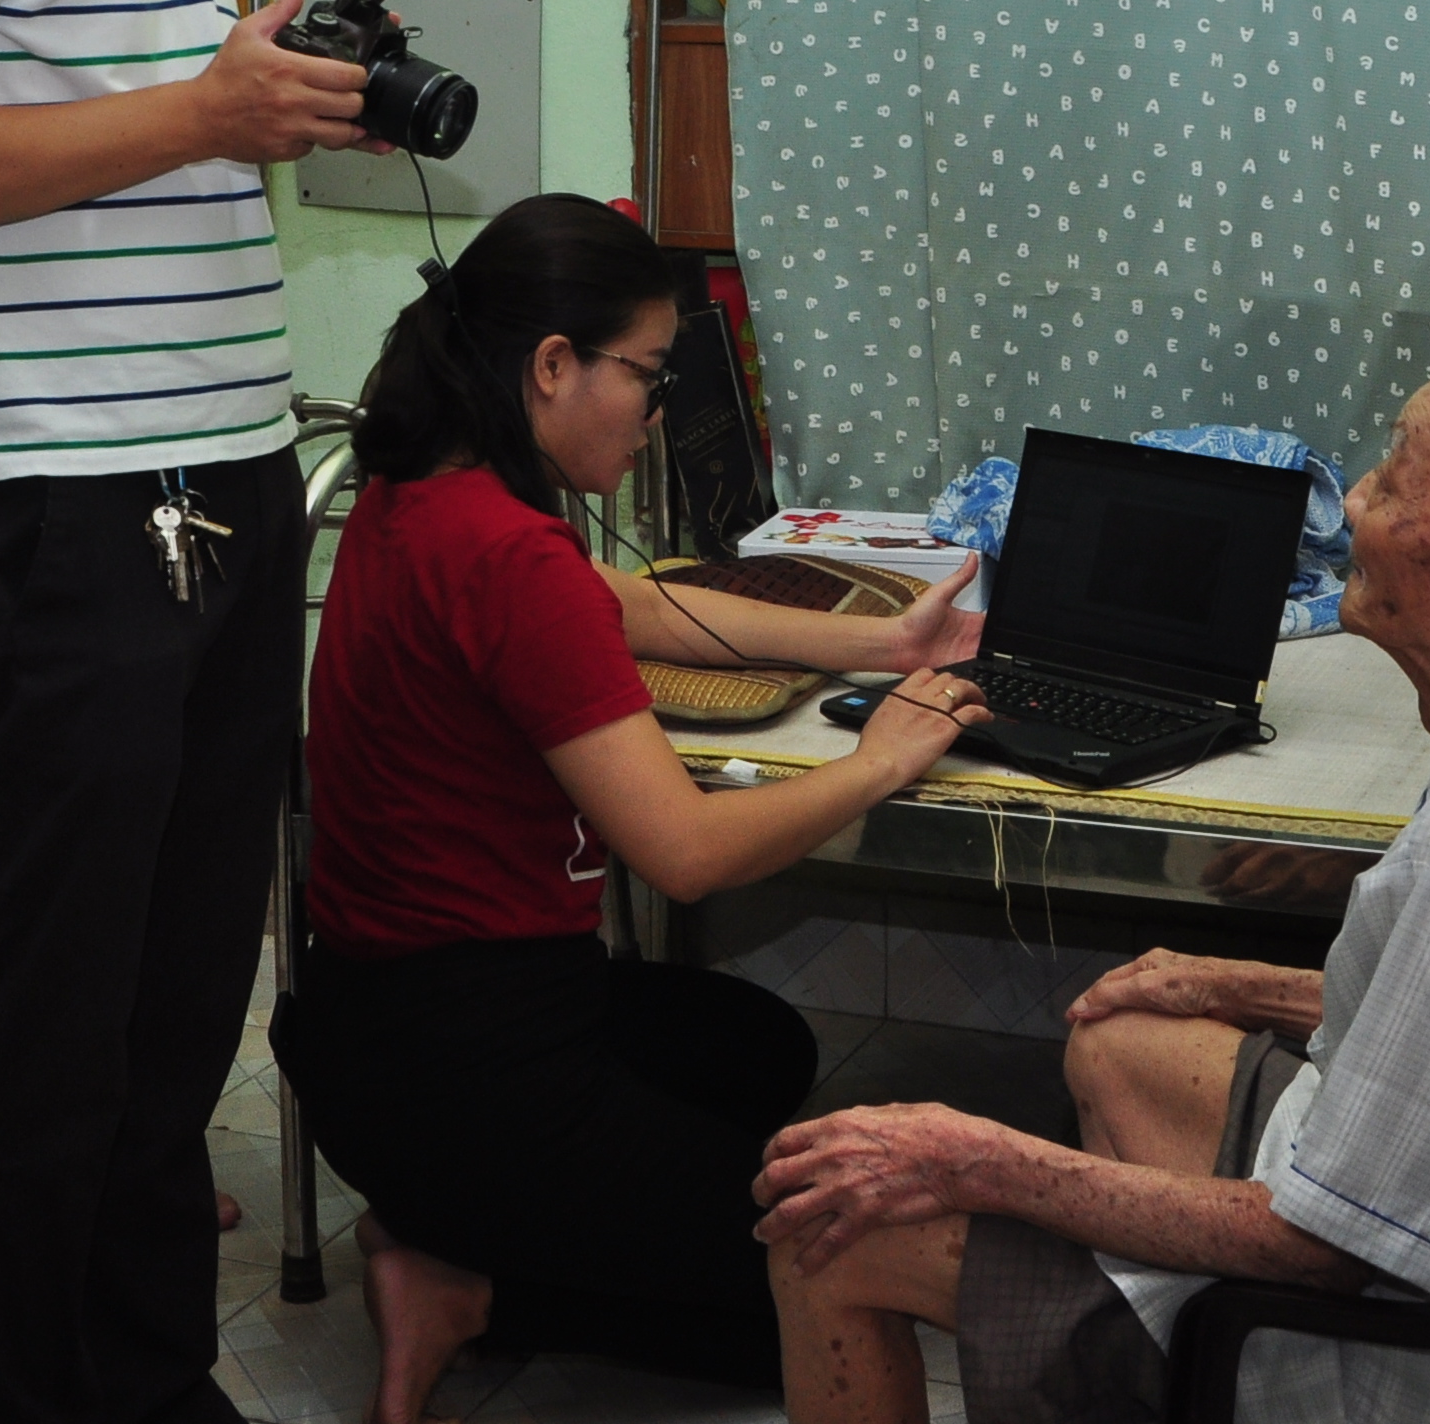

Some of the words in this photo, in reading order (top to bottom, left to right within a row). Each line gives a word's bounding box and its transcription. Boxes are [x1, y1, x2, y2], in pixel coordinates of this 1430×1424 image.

[997, 11, 1010, 25] C
[1342, 8, 1356, 23] A
[1198, 18, 1210, 32] C
[1012, 44, 1026, 58] M
[1385, 36, 1398, 51] C
[969, 64, 980, 78] E
[1169, 72, 1180, 87] E
[1400, 72, 1415, 86] M
[947, 89, 959, 104] A
[1061, 96, 1072, 111] B
[1355, 90, 1366, 105] E
[1146, 99, 1159, 114] A
[1254, 106, 1265, 122] B
[984, 114, 995, 128] F
[1184, 124, 1194, 139] F
[1414, 144, 1425, 160] H
[1242, 159, 1256, 174] A
[987, 224, 998, 238] E
[1251, 232, 1262, 248] B
[956, 248, 971, 264] A
[1374, 259, 1384, 274] E
[676, 427, 707, 449] BLACK
[708, 408, 738, 428] LABEL
